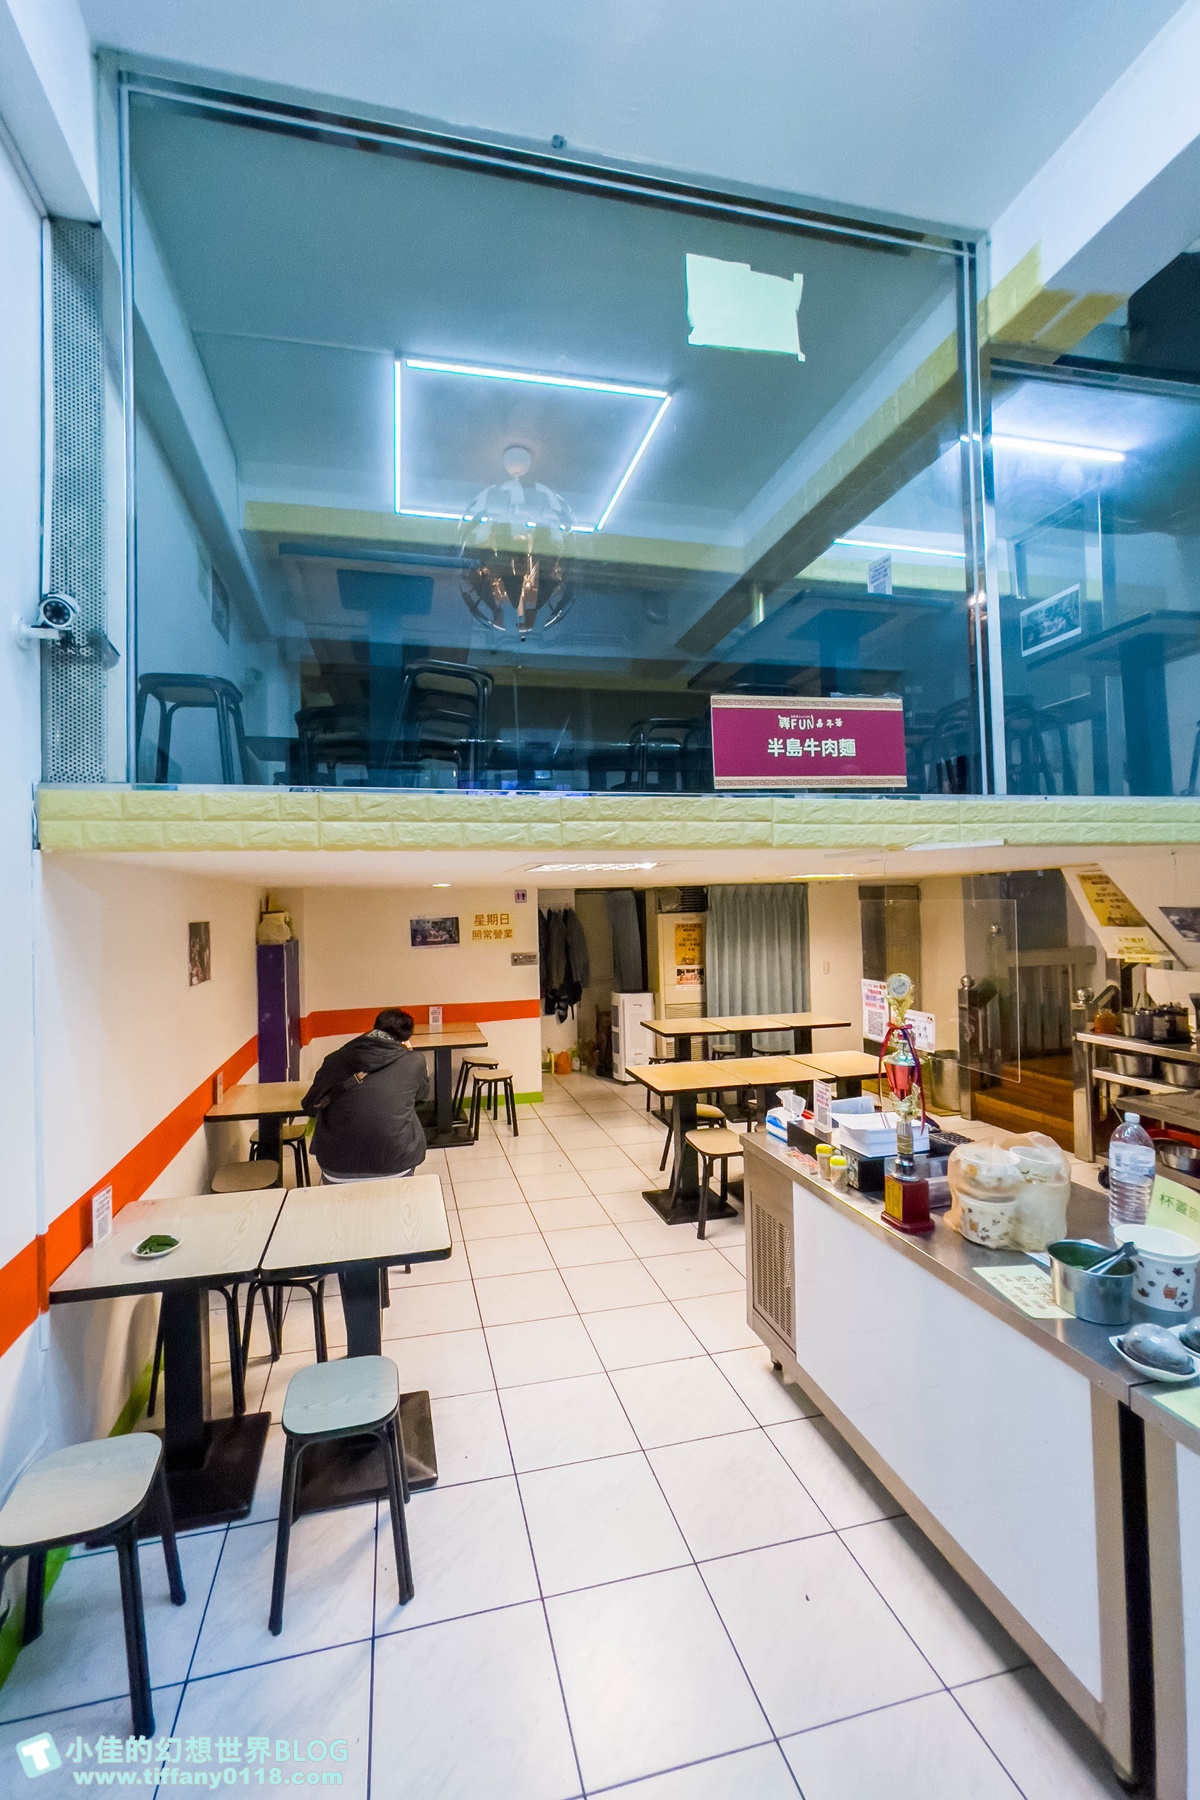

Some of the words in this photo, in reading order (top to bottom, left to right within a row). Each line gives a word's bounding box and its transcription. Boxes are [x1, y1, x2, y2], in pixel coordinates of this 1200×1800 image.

[767, 737, 856, 758] 半島牛肉麵
[474, 913, 510, 927] 星期日
[472, 929, 513, 941] 照常營業
